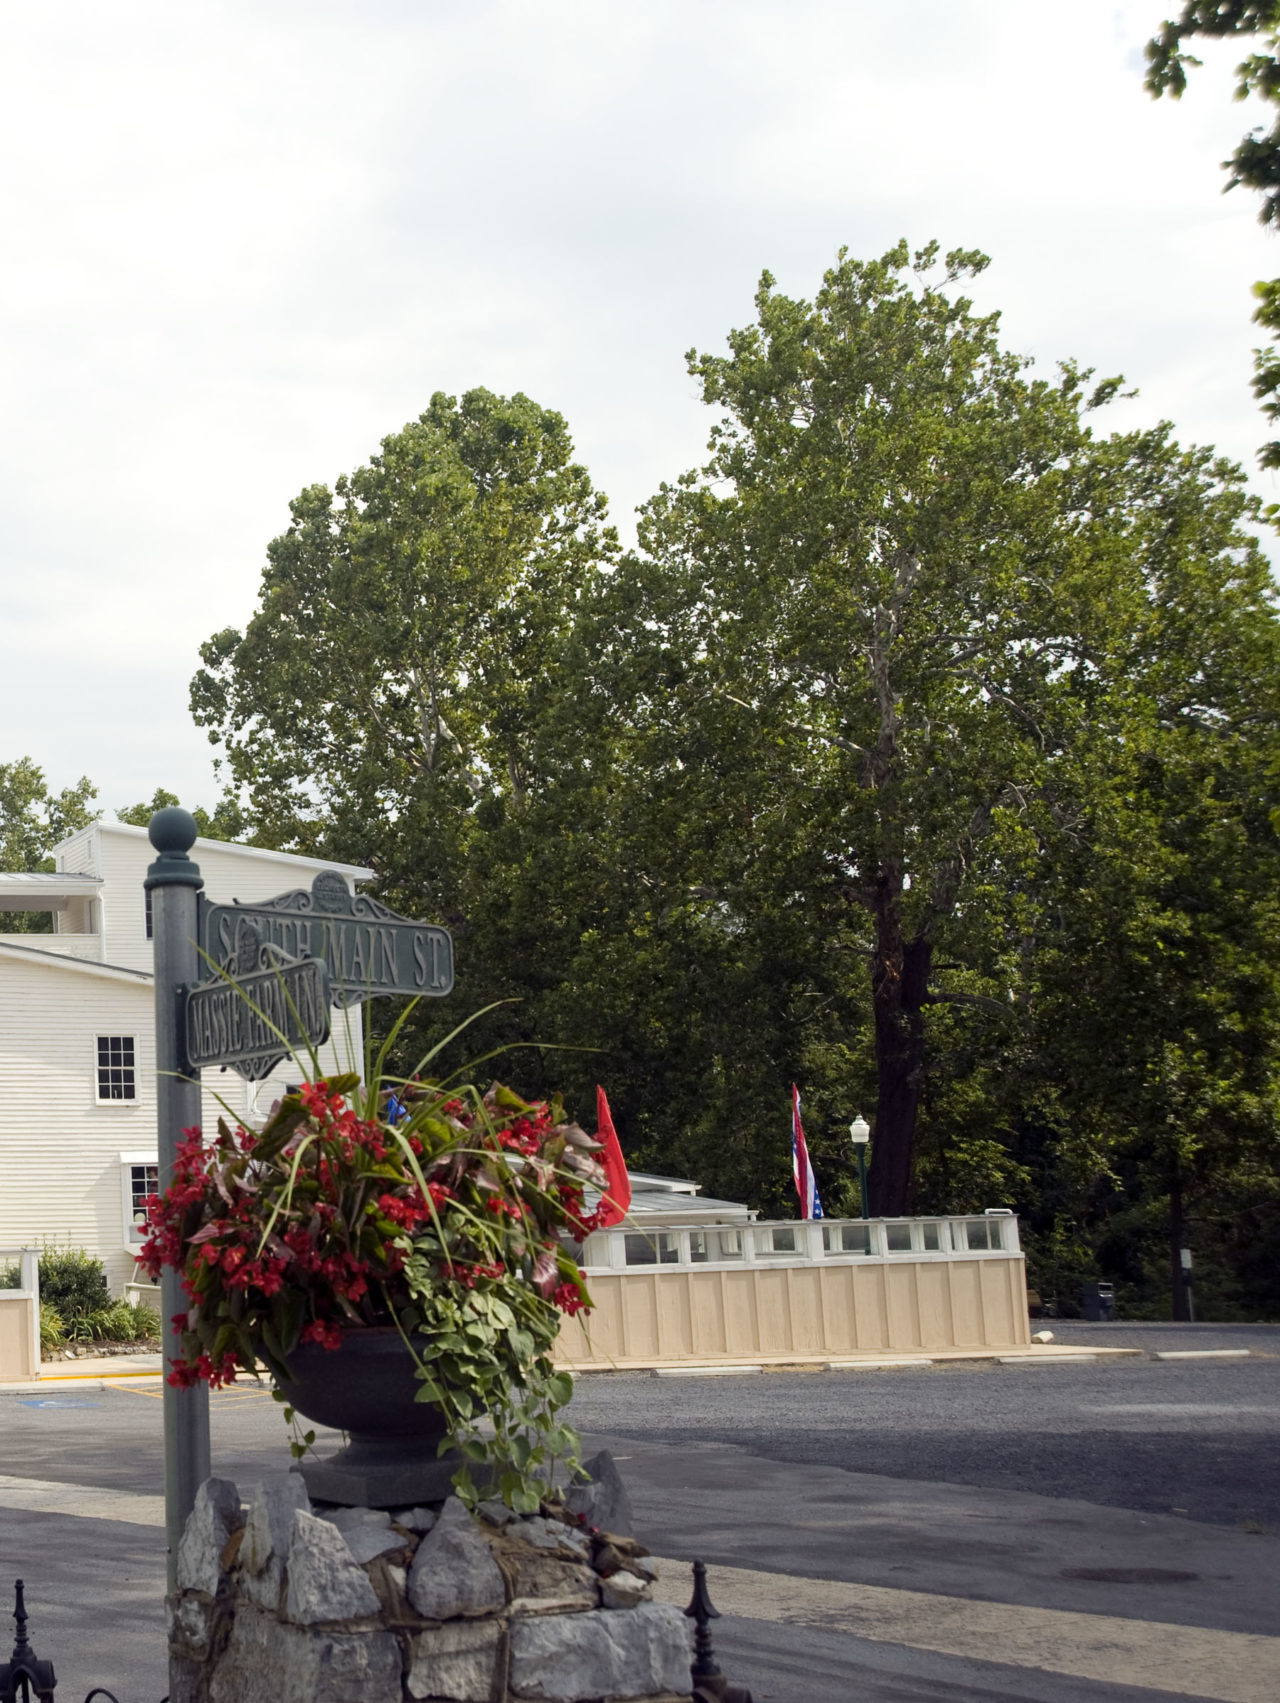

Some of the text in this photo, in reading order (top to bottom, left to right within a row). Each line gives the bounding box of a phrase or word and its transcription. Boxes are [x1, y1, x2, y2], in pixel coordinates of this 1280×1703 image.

[326, 922, 399, 985] MAIN
[413, 930, 447, 989] ST.
[192, 989, 242, 1059] MASSIE
[246, 976, 289, 1048] FARM
